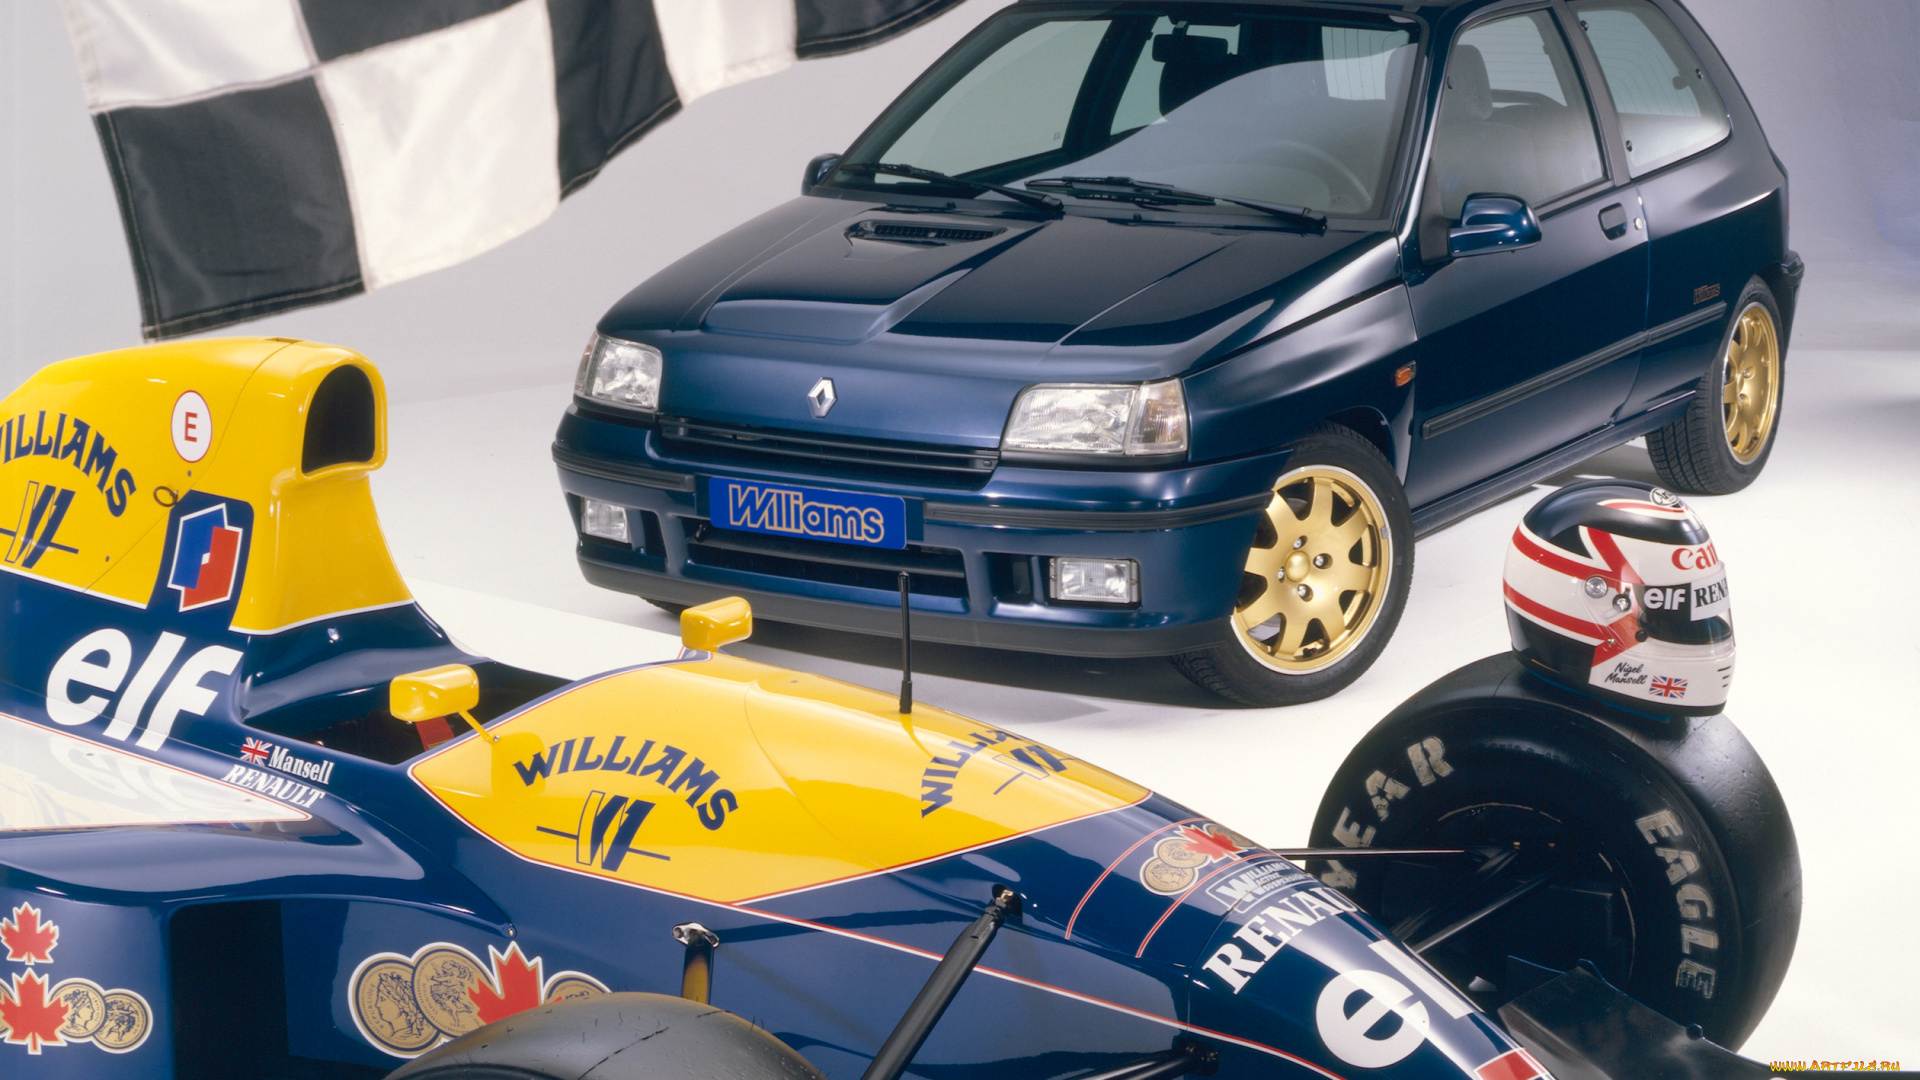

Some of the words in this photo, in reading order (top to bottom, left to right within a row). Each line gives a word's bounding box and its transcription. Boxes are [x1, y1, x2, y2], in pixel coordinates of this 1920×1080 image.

[184, 412, 198, 443] E
[729, 484, 885, 543] Williams
[1643, 586, 1686, 611] elf
[46, 628, 244, 752] elf
[1605, 671, 1649, 686] Mansell
[1614, 662, 1643, 676] Nigel
[220, 764, 327, 808] RENAULT
[268, 745, 334, 785] Mansell
[512, 735, 739, 831] WILLIAMS
[1635, 809, 1719, 1000] EAGLE
